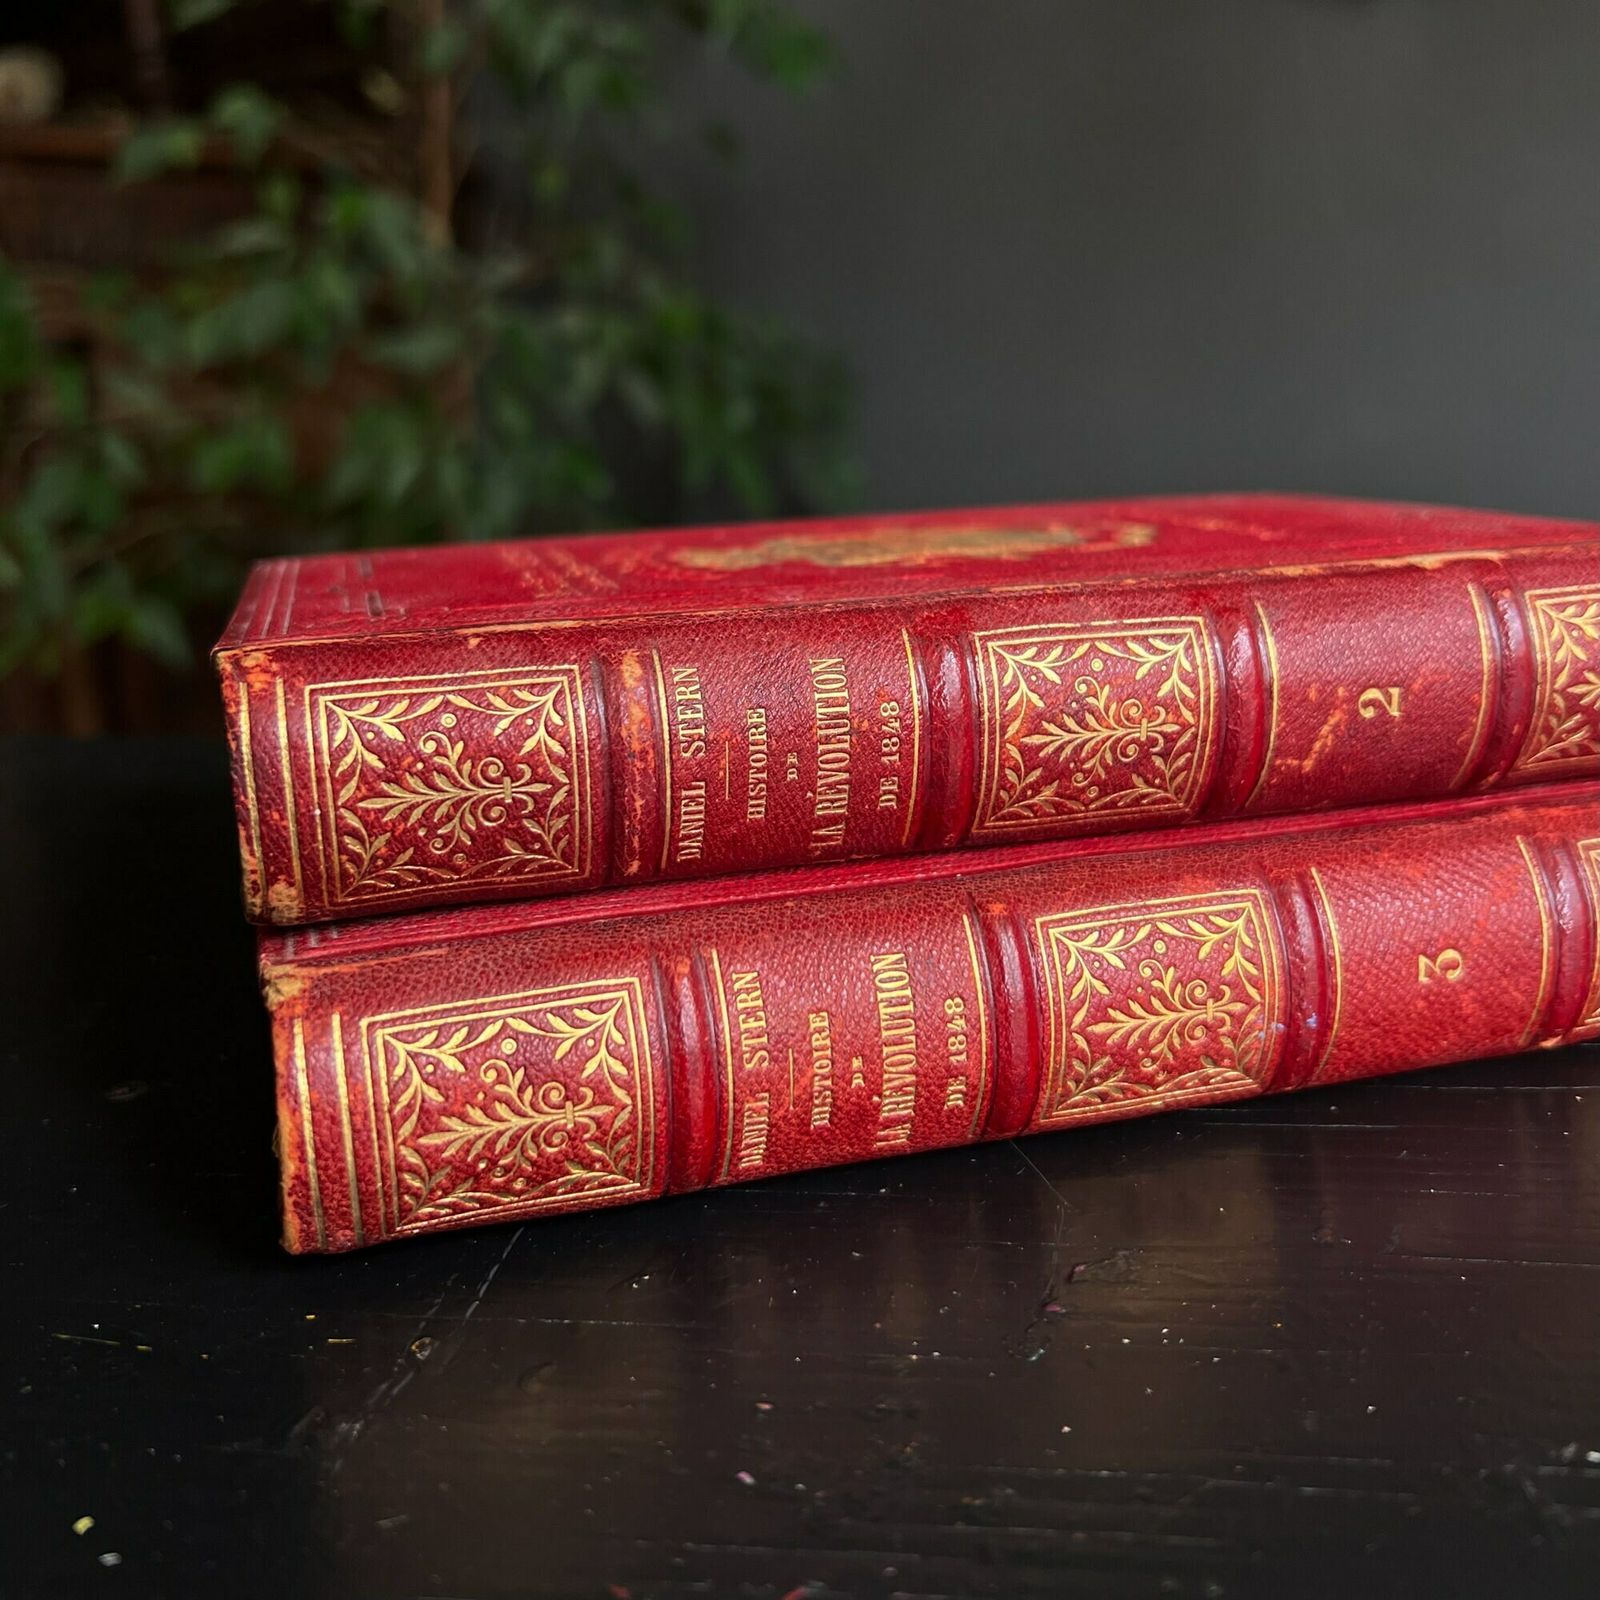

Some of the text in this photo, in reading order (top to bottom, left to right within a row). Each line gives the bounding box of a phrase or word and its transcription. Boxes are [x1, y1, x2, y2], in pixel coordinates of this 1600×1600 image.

[806, 657, 850, 817] RÉVOLUTION
[877, 700, 900, 811] DE 1848
[1358, 686, 1401, 719] 2
[672, 667, 706, 862] DANIEL STERN
[747, 708, 768, 822] HISTOIRE
[786, 752, 799, 782] DE
[732, 971, 769, 1070] STERN
[1418, 947, 1465, 984] 3
[808, 1011, 832, 1131] HISTOIRE
[851, 1056, 865, 1089] DE
[870, 952, 917, 1120] RÉVOLUTION
[943, 997, 968, 1111] DE 1848
